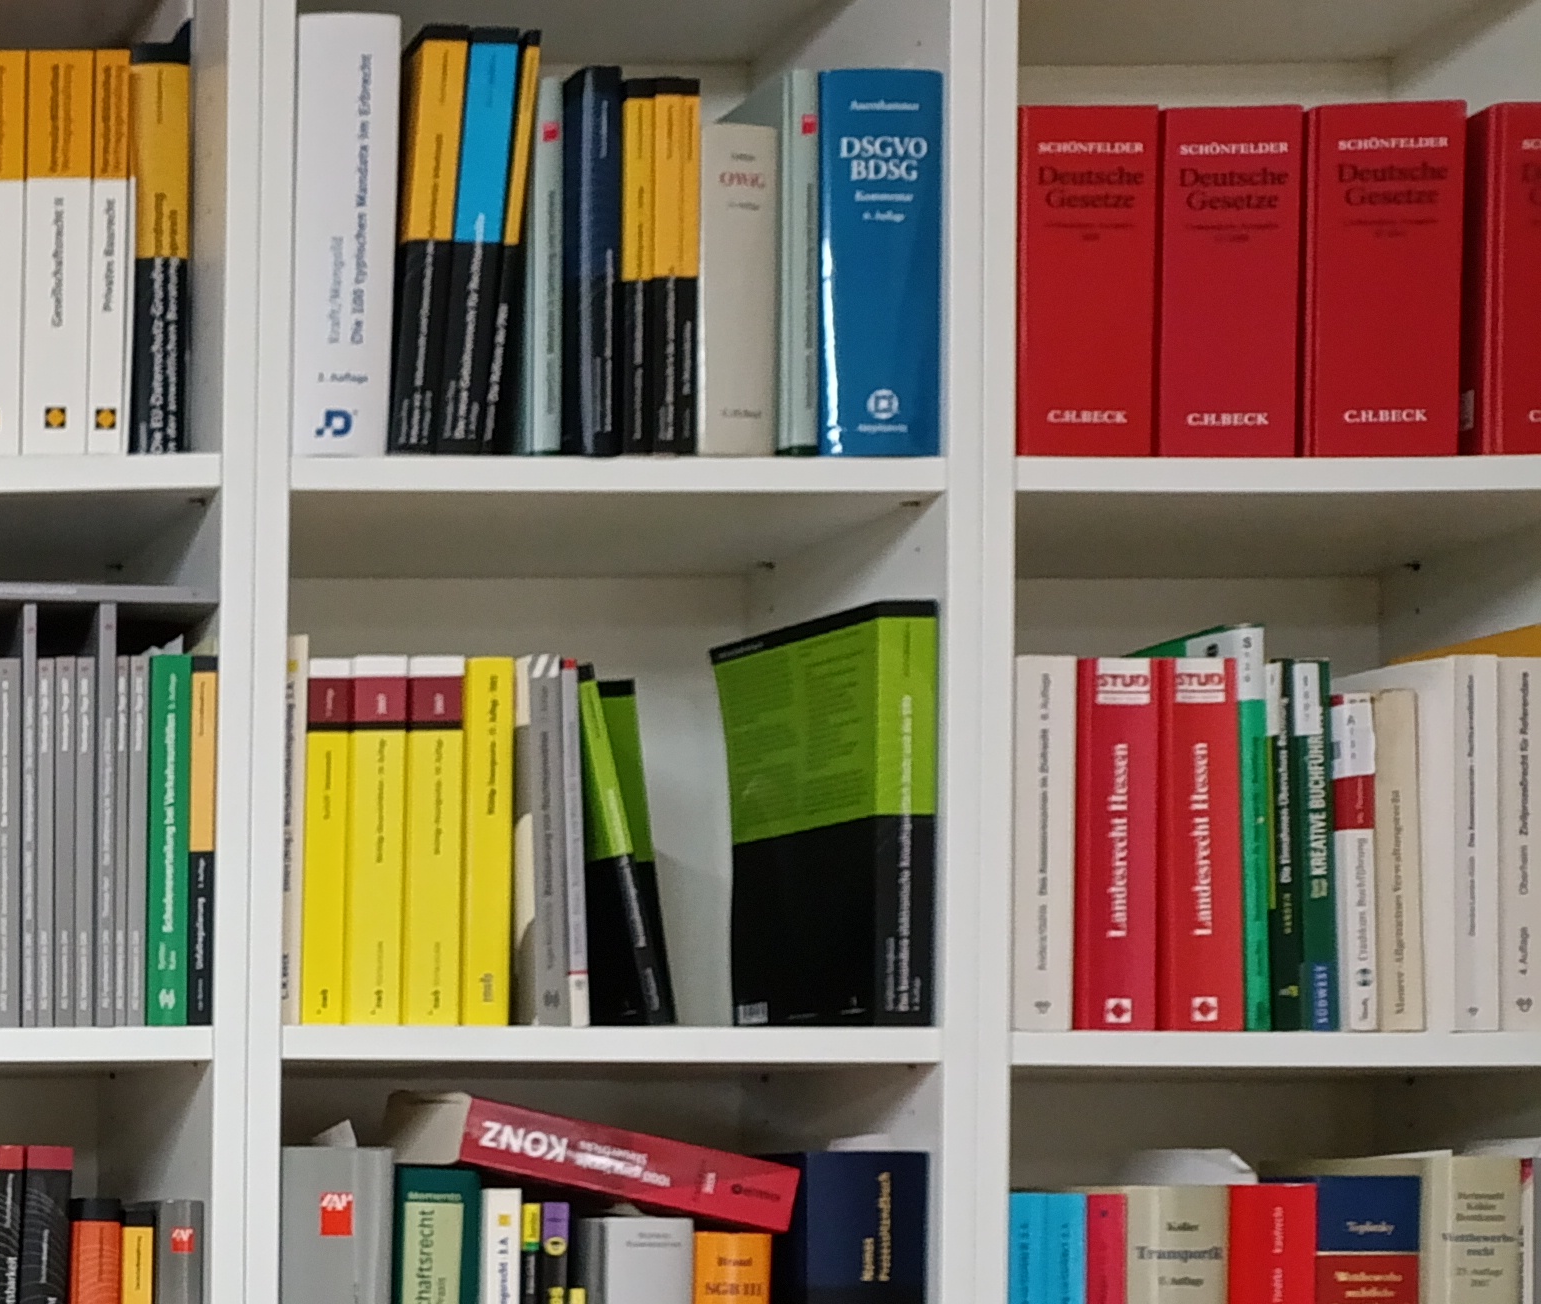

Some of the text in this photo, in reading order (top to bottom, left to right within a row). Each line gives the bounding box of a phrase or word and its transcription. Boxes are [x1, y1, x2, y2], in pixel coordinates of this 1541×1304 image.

[840, 136, 928, 159] DSGVO
[1037, 142, 1144, 154] SCHÖNFELDER
[1180, 142, 1288, 155] SCHÖNFELDER
[1338, 136, 1448, 150] SCHÖNFELDER
[850, 159, 918, 182] BDSG
[1037, 166, 1144, 187] Deutsche
[1045, 189, 1135, 209] Gesetze
[1187, 412, 1269, 426] C.H.BECK
[1344, 409, 1427, 423] C.H.BECK
[1106, 744, 1129, 938] Landesrecht Hessen
[1191, 743, 1214, 935] Landesrecht Hessen
[478, 1120, 567, 1159] KONZ
